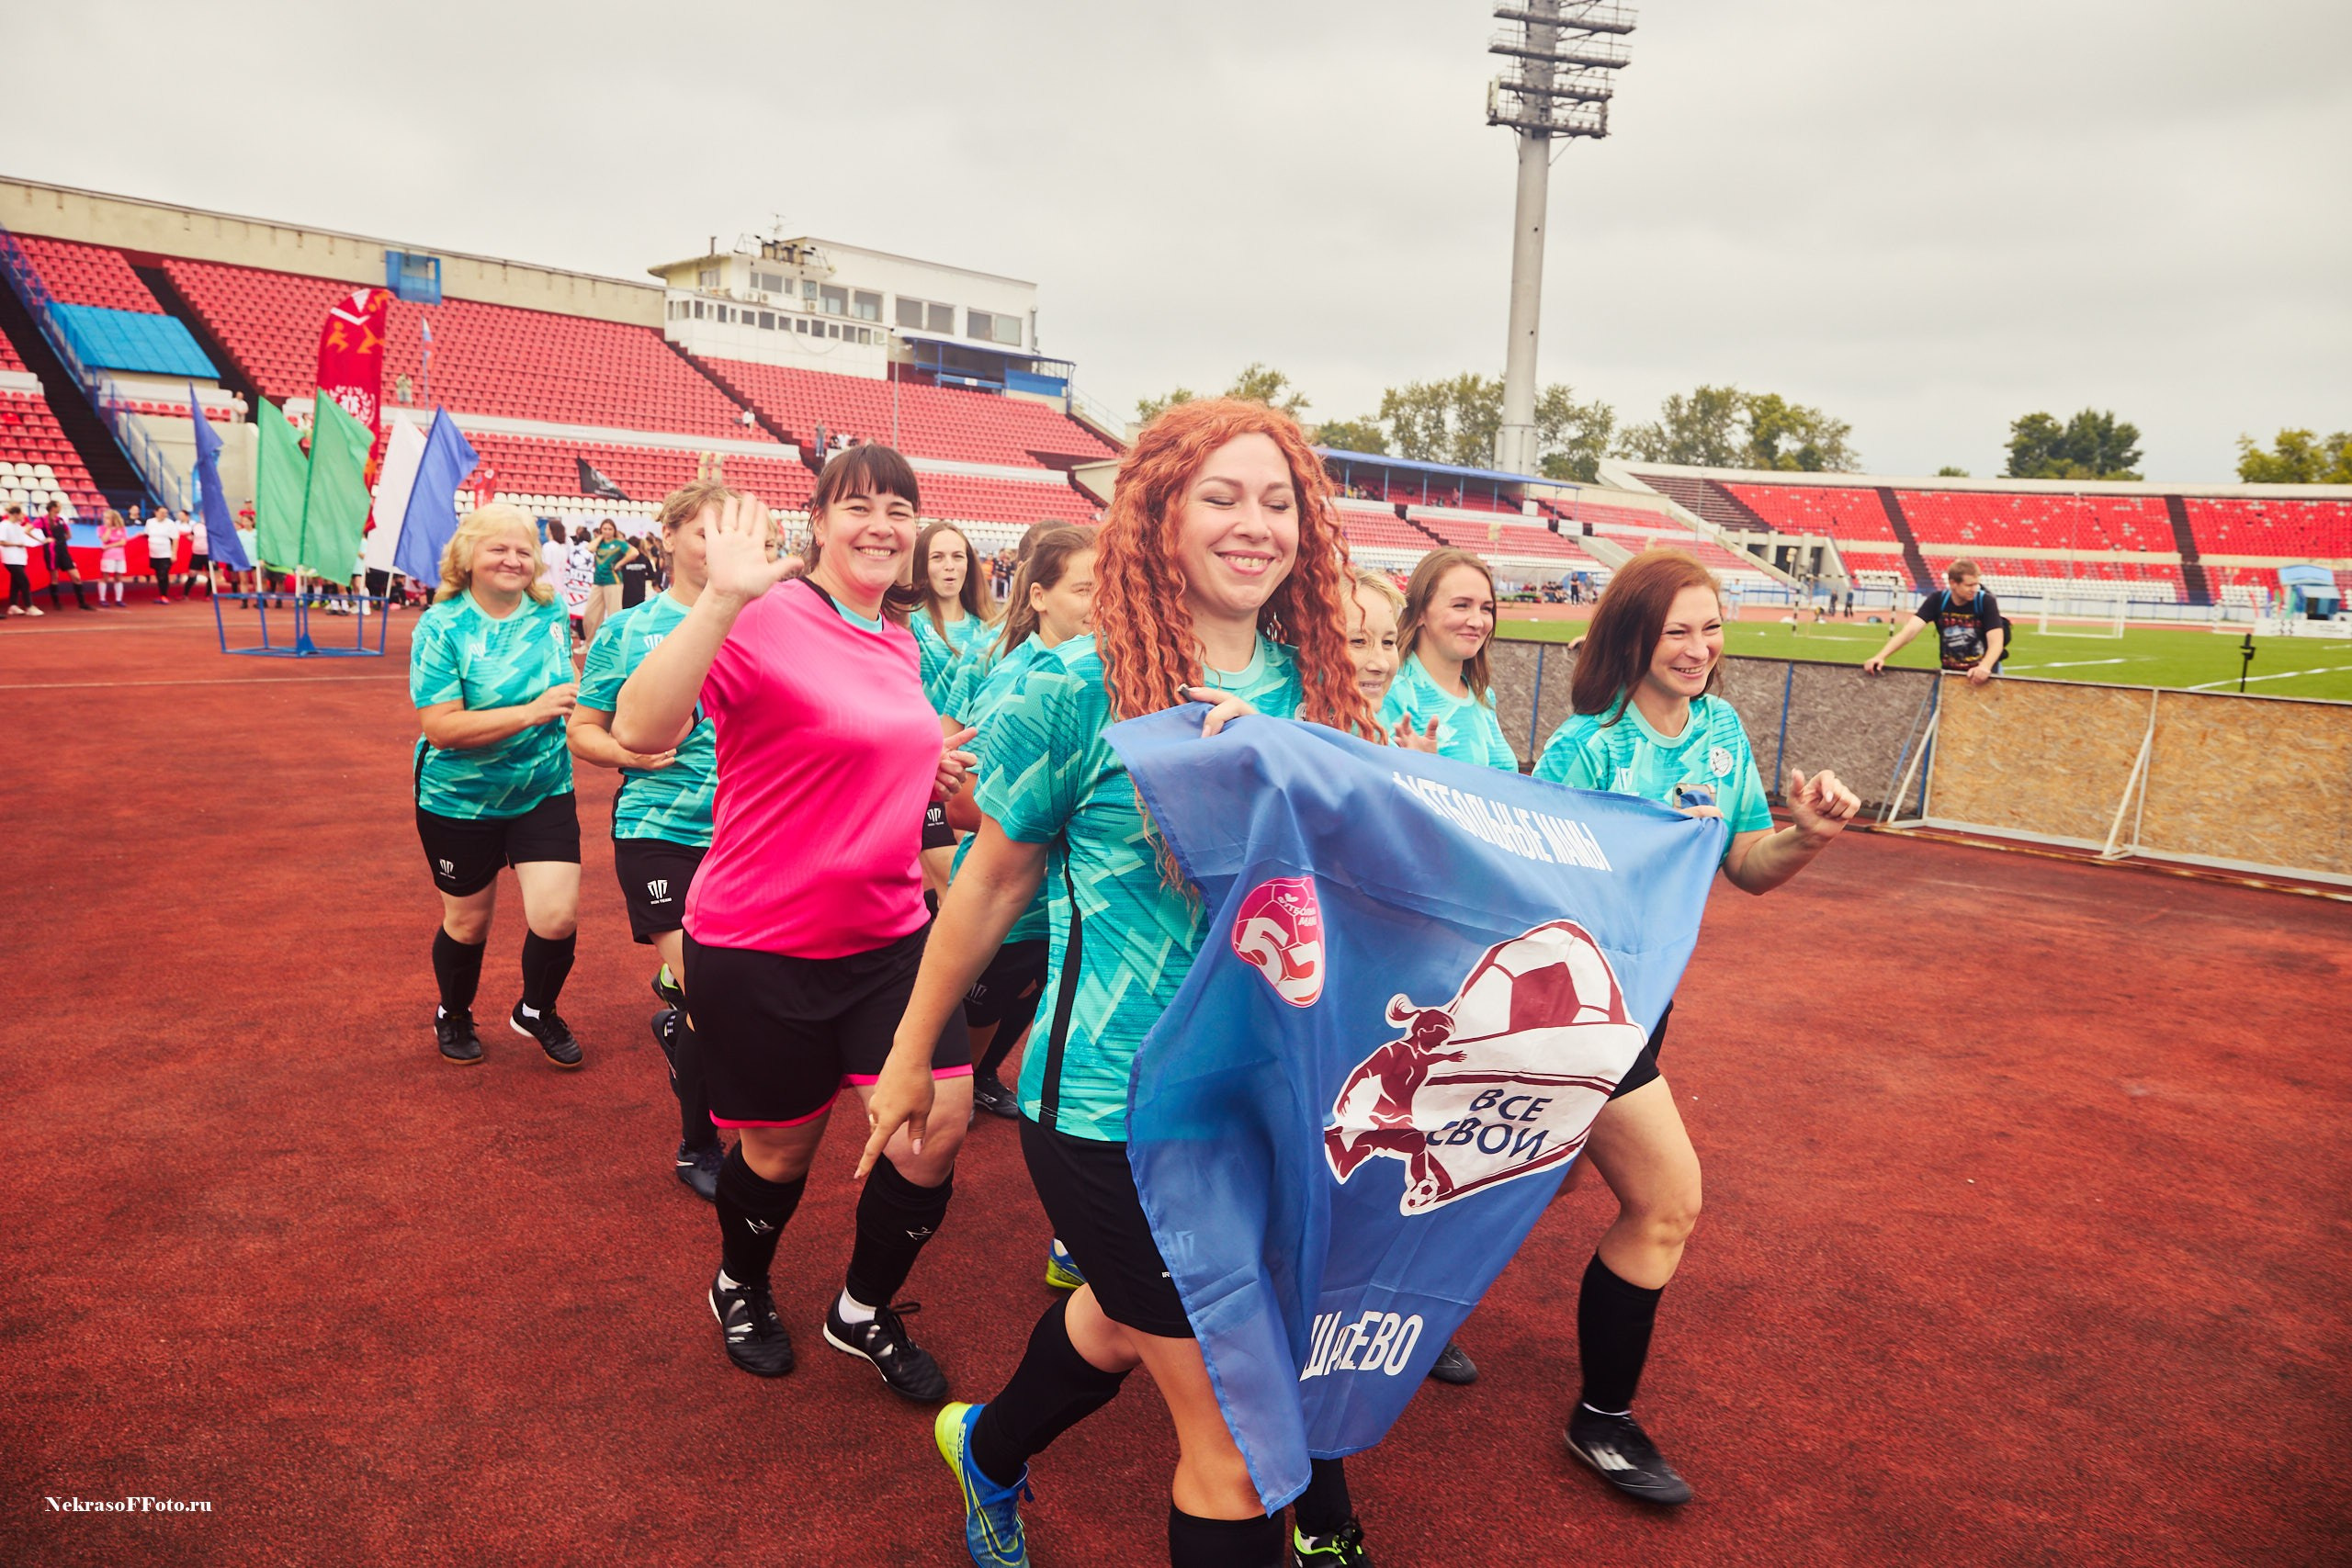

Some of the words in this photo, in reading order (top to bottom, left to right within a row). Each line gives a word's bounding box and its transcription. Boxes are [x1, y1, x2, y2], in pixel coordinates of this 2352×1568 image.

[1531, 810, 1612, 872] МАМЫ
[1469, 1089, 1554, 1122] ВСЕ
[1426, 1117, 1550, 1160] СВОИ
